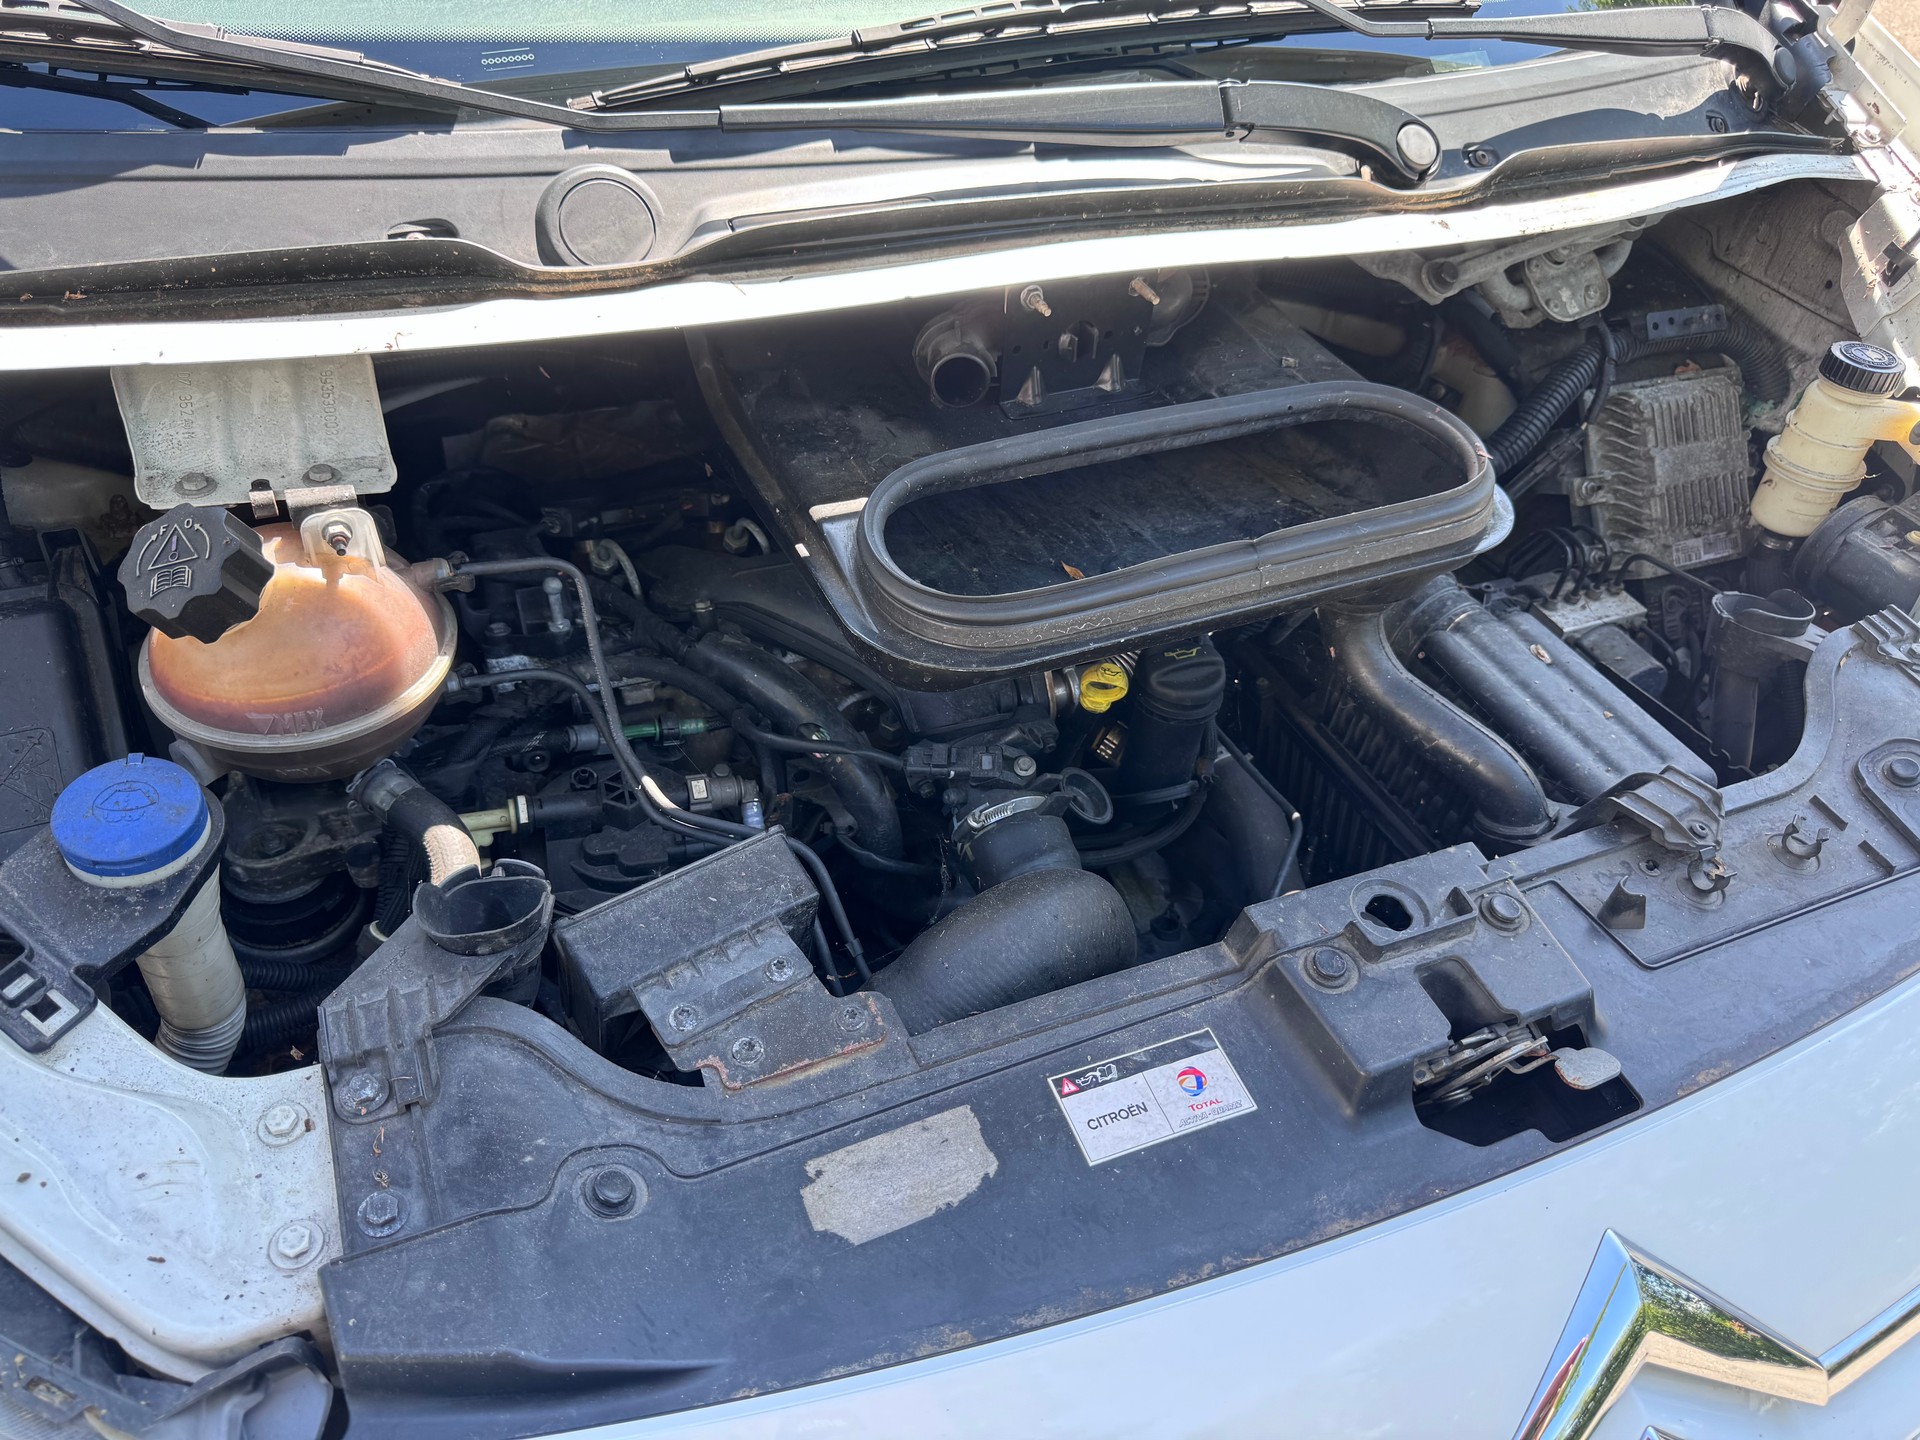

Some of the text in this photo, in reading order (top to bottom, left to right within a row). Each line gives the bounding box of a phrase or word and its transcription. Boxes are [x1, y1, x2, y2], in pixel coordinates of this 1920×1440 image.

[159, 524, 169, 536] F
[272, 706, 328, 737] MAX
[1086, 1101, 1149, 1131] CITROËN
[1187, 1099, 1224, 1112] TOTAL
